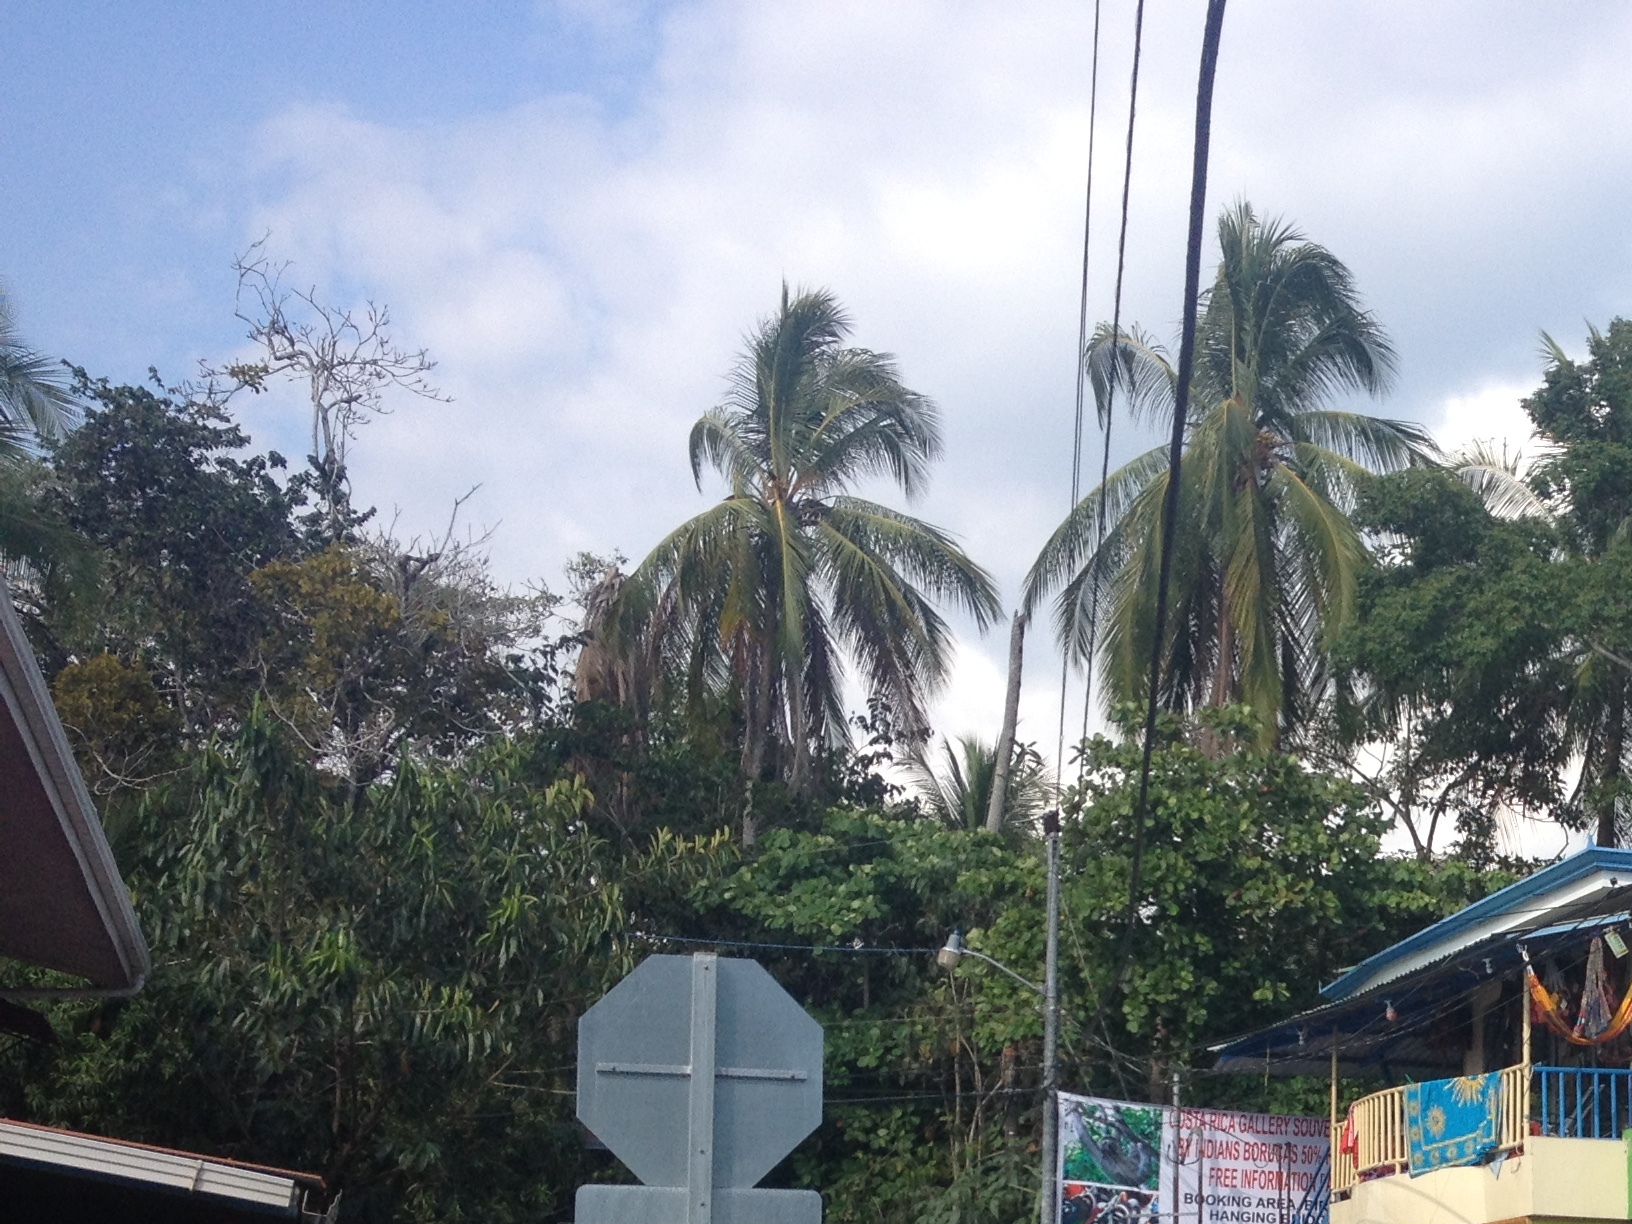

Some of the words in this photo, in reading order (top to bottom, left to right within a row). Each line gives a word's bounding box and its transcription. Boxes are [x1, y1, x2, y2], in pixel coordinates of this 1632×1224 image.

[1210, 1112, 1235, 1133] RICA
[1239, 1114, 1290, 1137] GALLERY
[1209, 1167, 1237, 1188] FREE
[1184, 1192, 1252, 1207] BOOKING
[1210, 1210, 1277, 1224] HANGING
